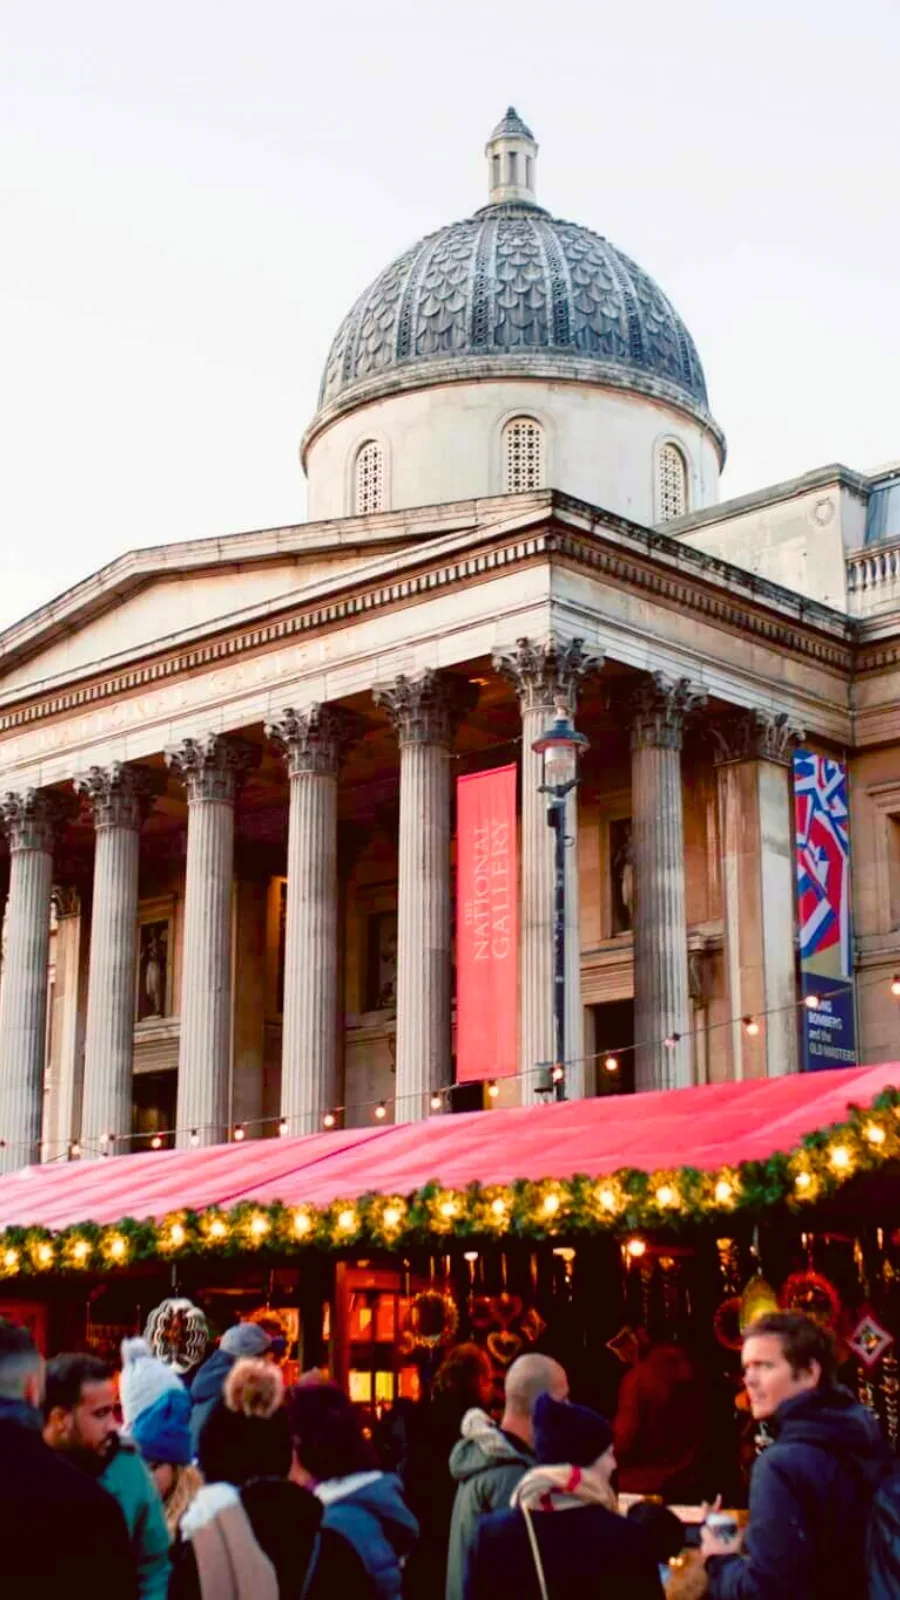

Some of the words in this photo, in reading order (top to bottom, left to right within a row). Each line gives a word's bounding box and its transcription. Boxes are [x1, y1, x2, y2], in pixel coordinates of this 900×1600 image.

[474, 820, 489, 961] NATIONAL
[491, 817, 511, 959] GALLERY
[809, 1041, 823, 1056] OLD
